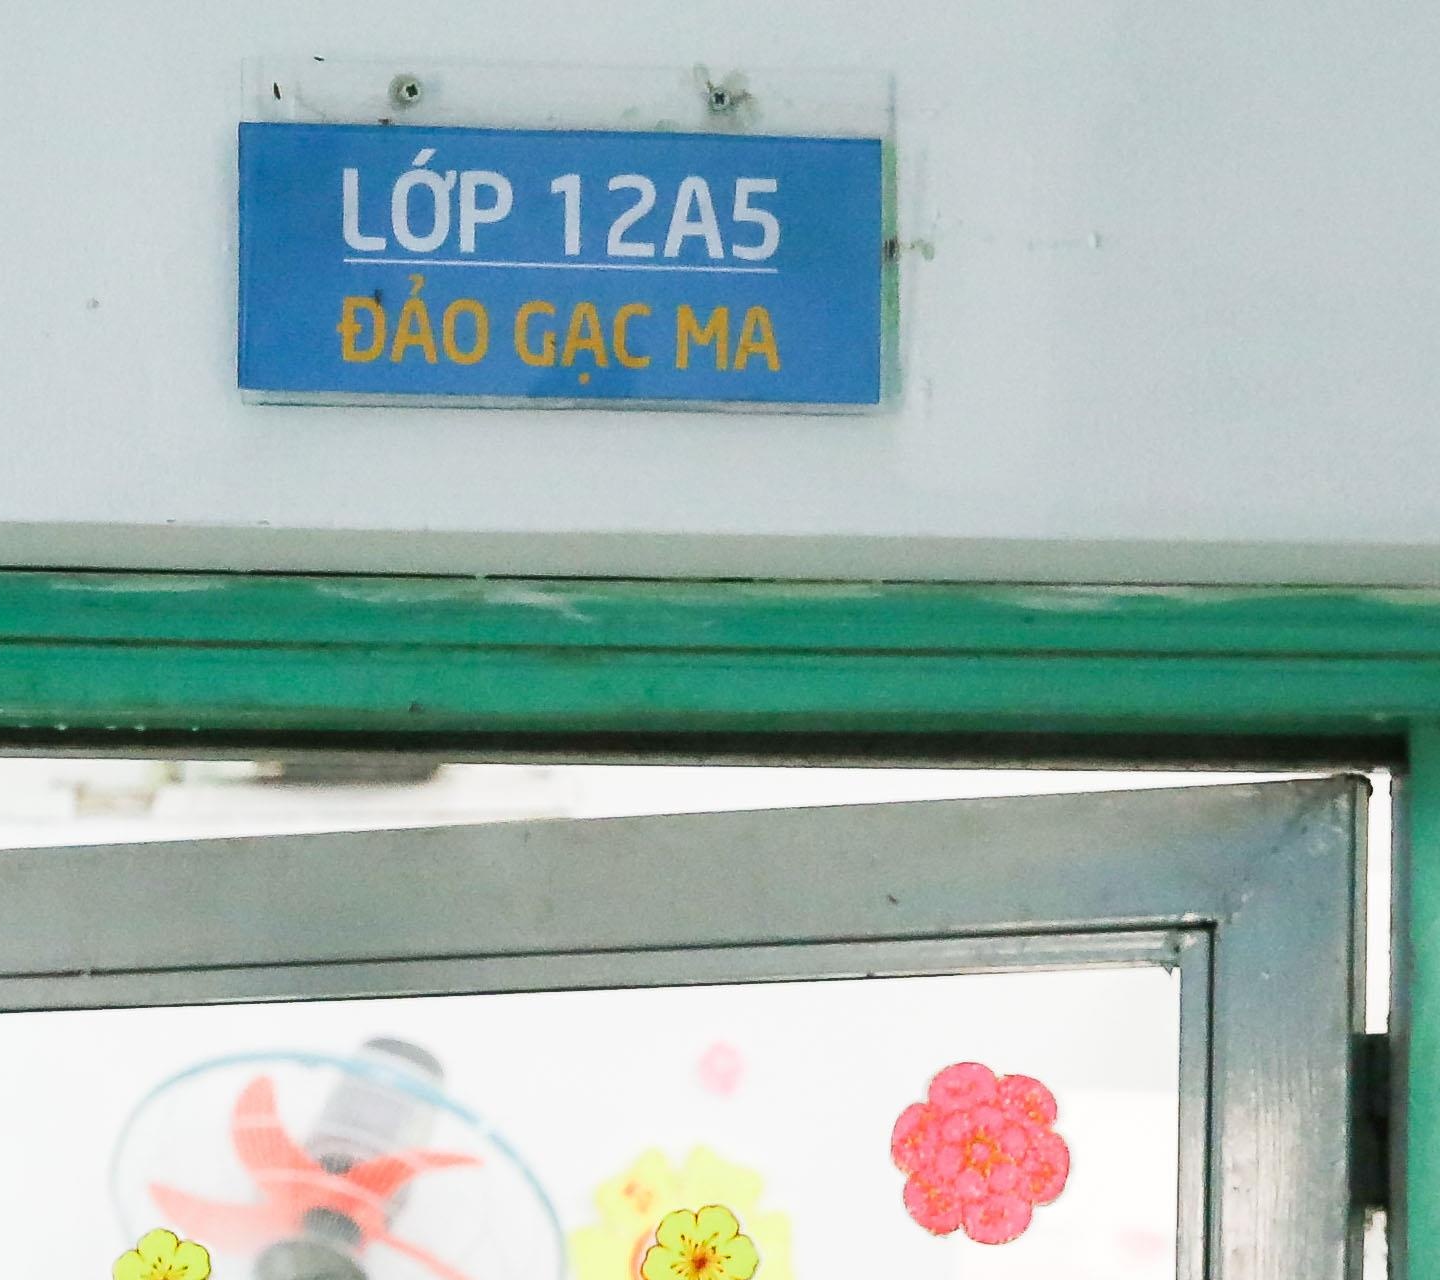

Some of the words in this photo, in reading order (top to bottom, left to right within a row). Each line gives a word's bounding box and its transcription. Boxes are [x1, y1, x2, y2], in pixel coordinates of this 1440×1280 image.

[342, 149, 514, 255] LỚP
[550, 174, 781, 262] 12A5
[336, 274, 490, 366] ĐẢO
[514, 300, 652, 386] GẠC
[676, 305, 781, 373] MA
